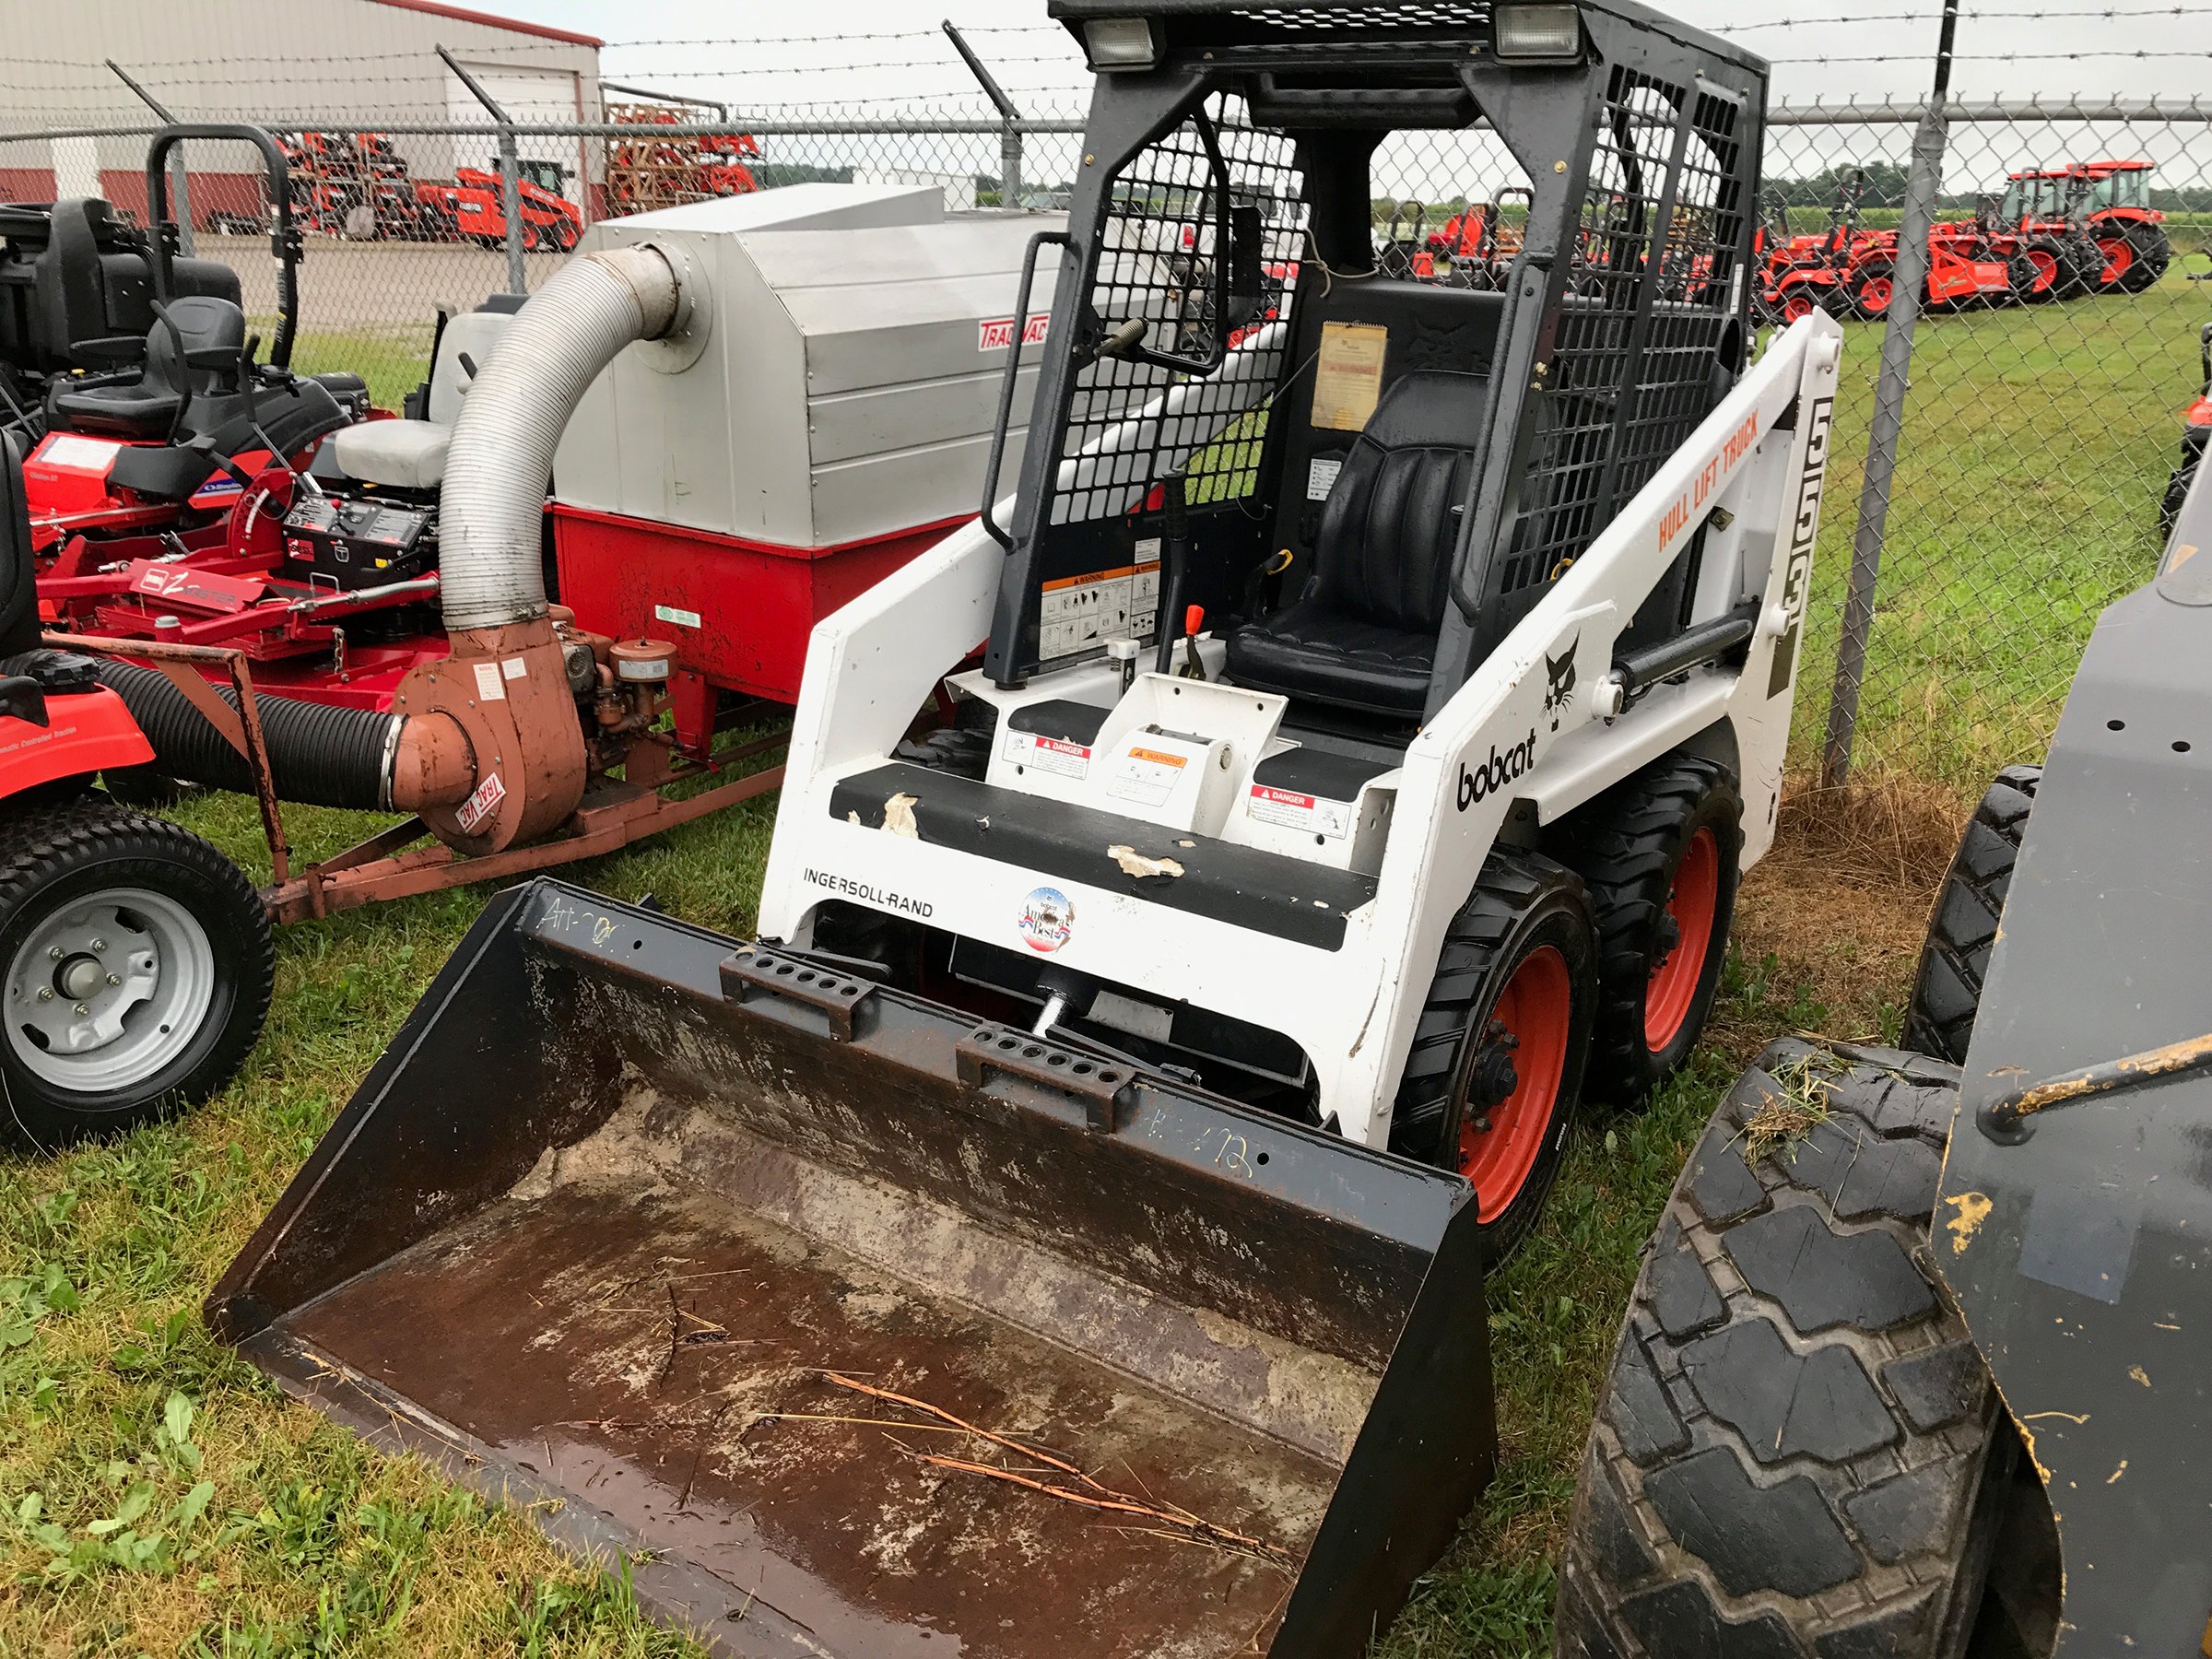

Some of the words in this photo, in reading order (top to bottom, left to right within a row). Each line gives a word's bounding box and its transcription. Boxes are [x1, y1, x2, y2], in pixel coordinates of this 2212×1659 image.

[1658, 493, 1688, 553] HULL
[1694, 454, 1719, 510] LIFT
[1723, 407, 1759, 474] TRUCK
[1079, 571, 1105, 583] WARNING
[1052, 742, 1084, 757] DANGER
[1147, 752, 1182, 766] WARNING
[1457, 727, 1536, 813] bobcat
[476, 776, 503, 813] TRAC
[1272, 792, 1306, 805] DANGER
[460, 800, 479, 830] VAC
[804, 867, 933, 918] INGERSOLL-RAND
